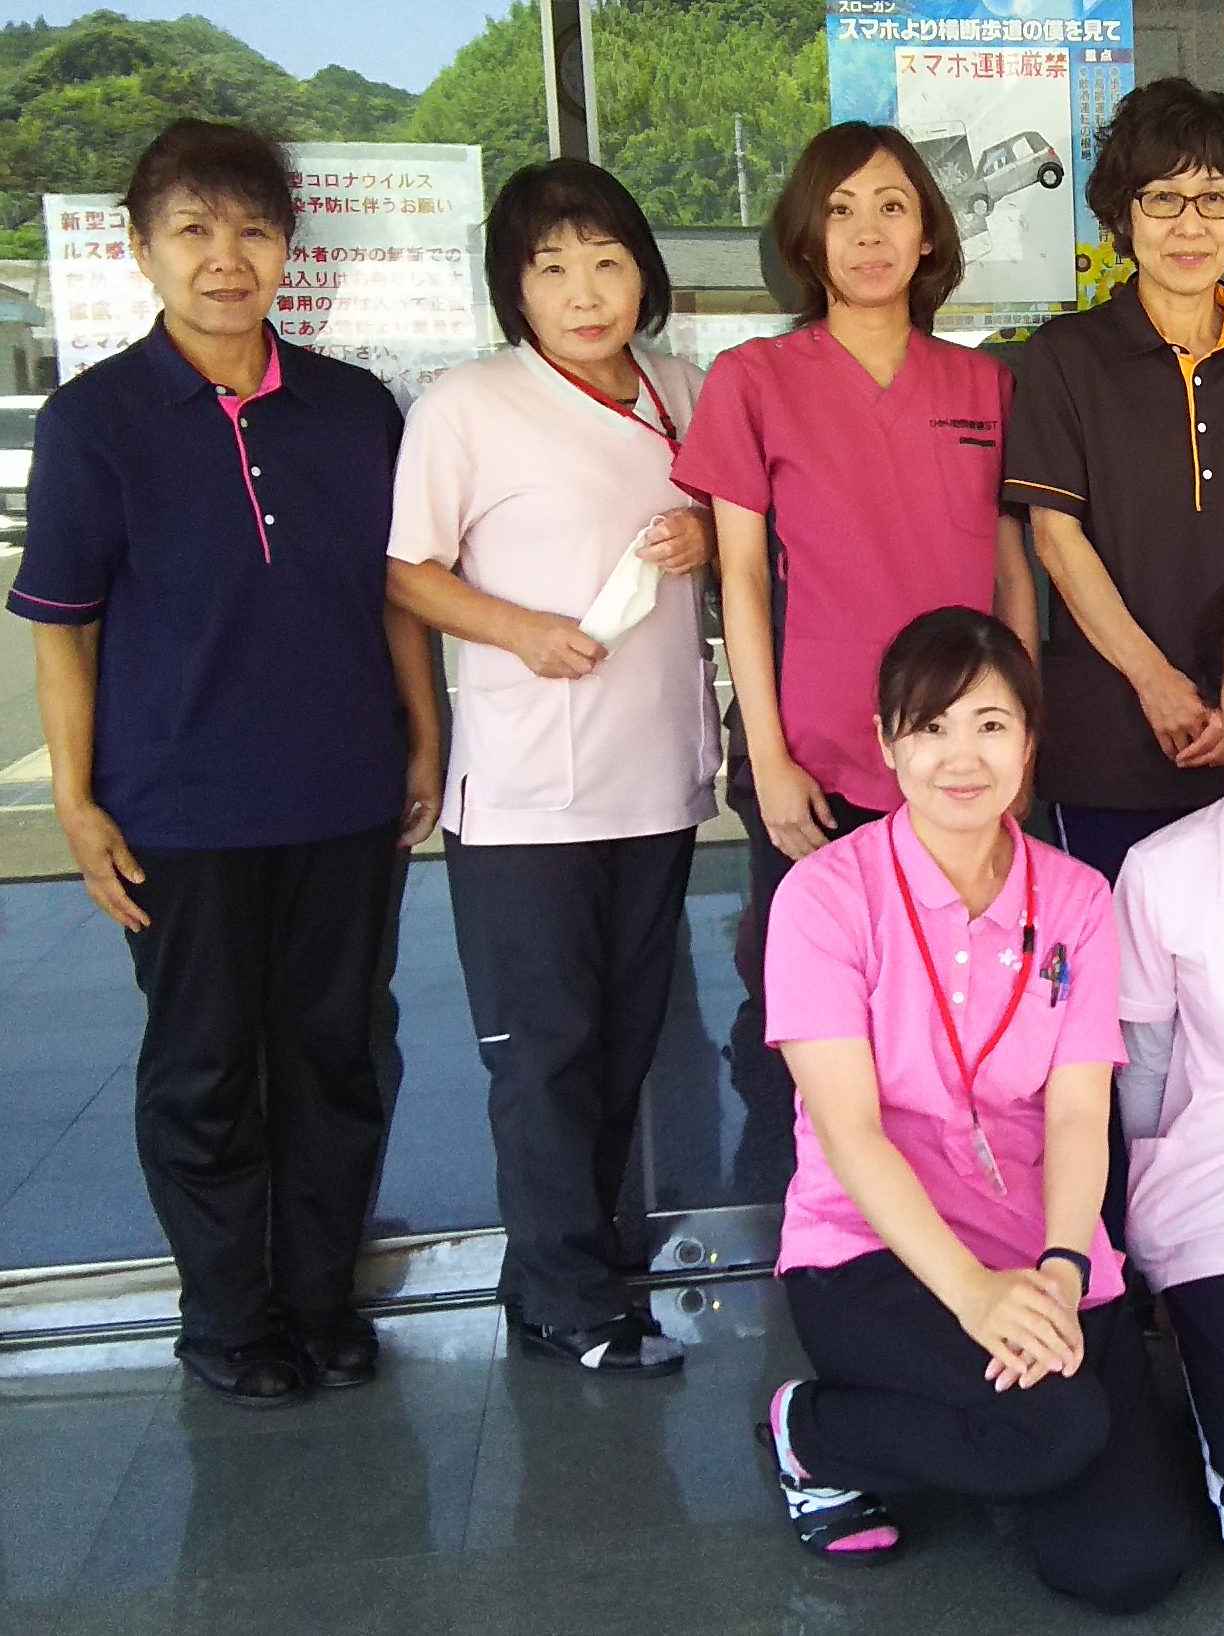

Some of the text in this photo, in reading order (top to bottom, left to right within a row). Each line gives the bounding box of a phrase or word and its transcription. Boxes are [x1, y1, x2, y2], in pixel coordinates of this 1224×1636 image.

[839, 0, 896, 13] スローガン
[838, 18, 1122, 42] スマホより横断歩道の僕を見て
[900, 51, 1068, 79] スマホ運転厳禁
[63, 241, 134, 260] ルス感
